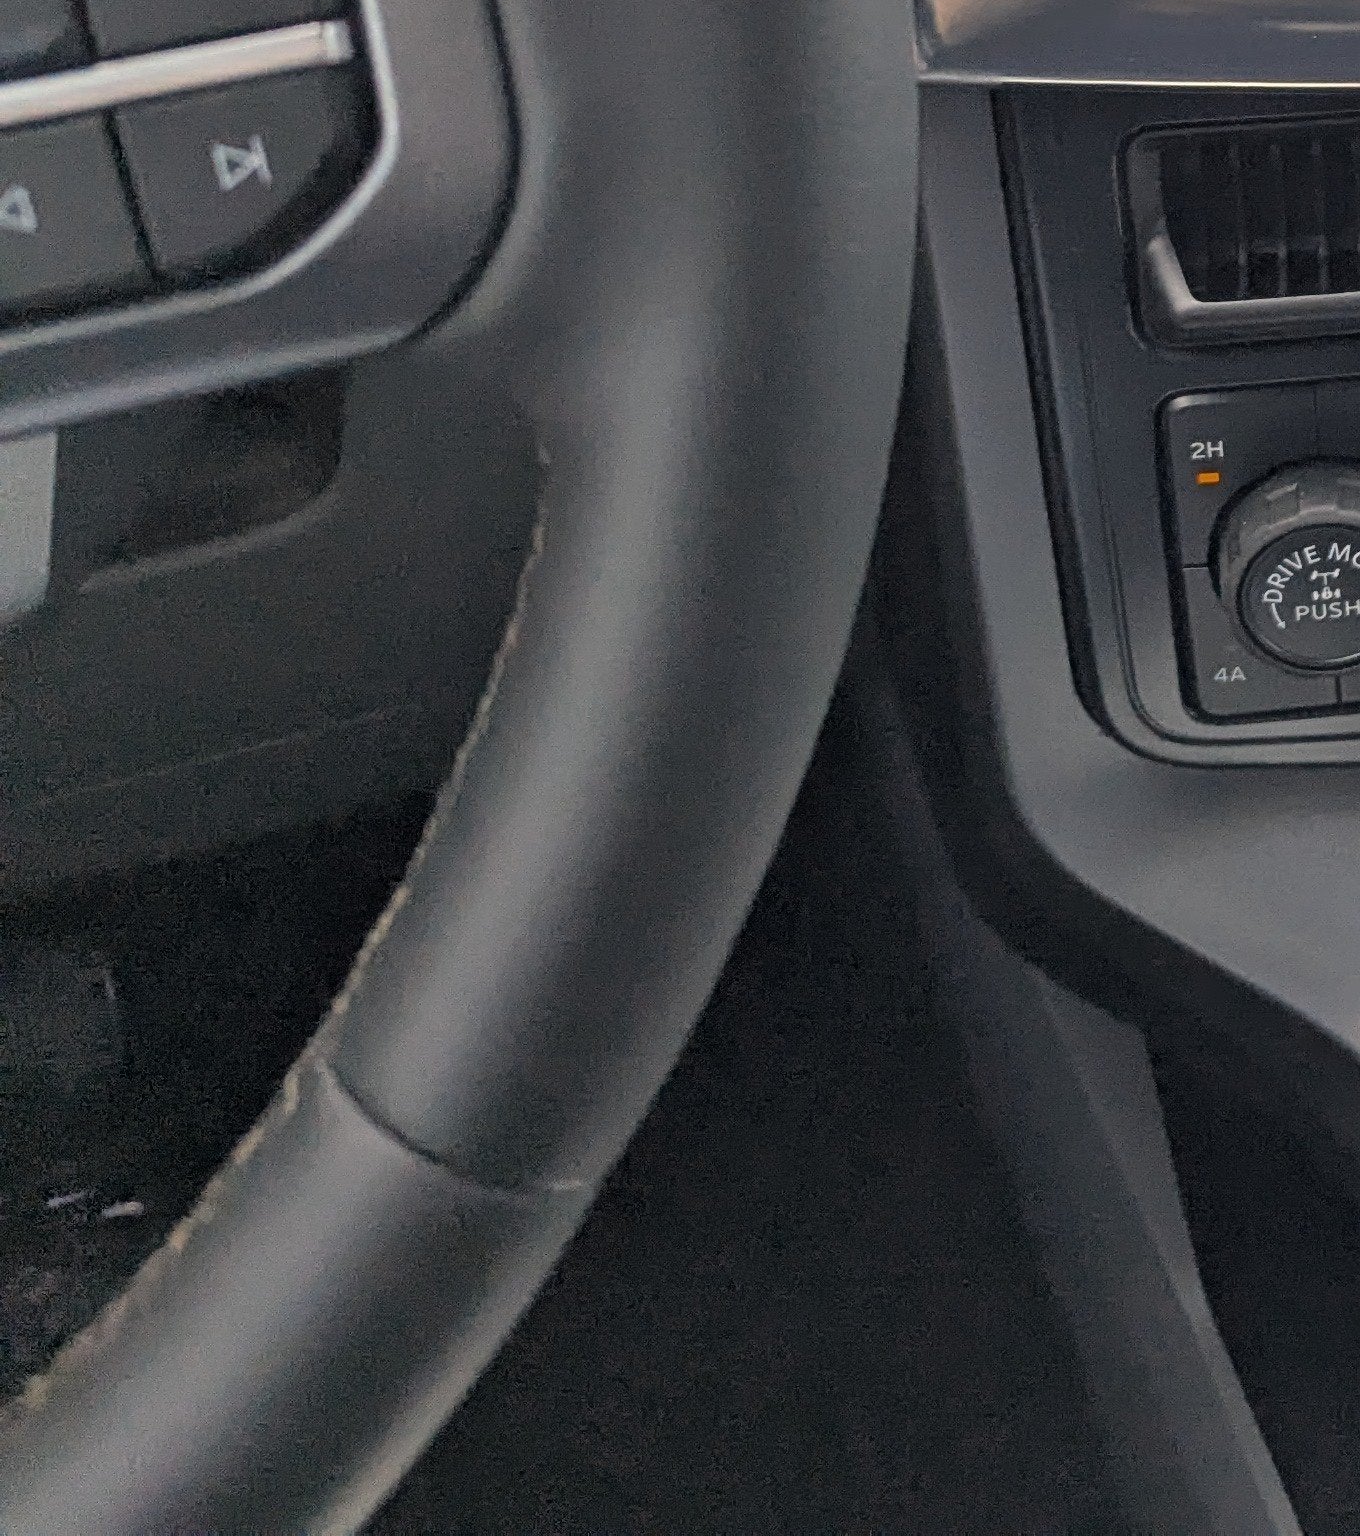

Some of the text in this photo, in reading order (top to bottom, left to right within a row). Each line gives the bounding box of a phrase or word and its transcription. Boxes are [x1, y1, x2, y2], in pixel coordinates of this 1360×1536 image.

[1189, 440, 1225, 461] 2H
[1262, 544, 1321, 604] DRIVE
[1213, 665, 1247, 683] 4A
